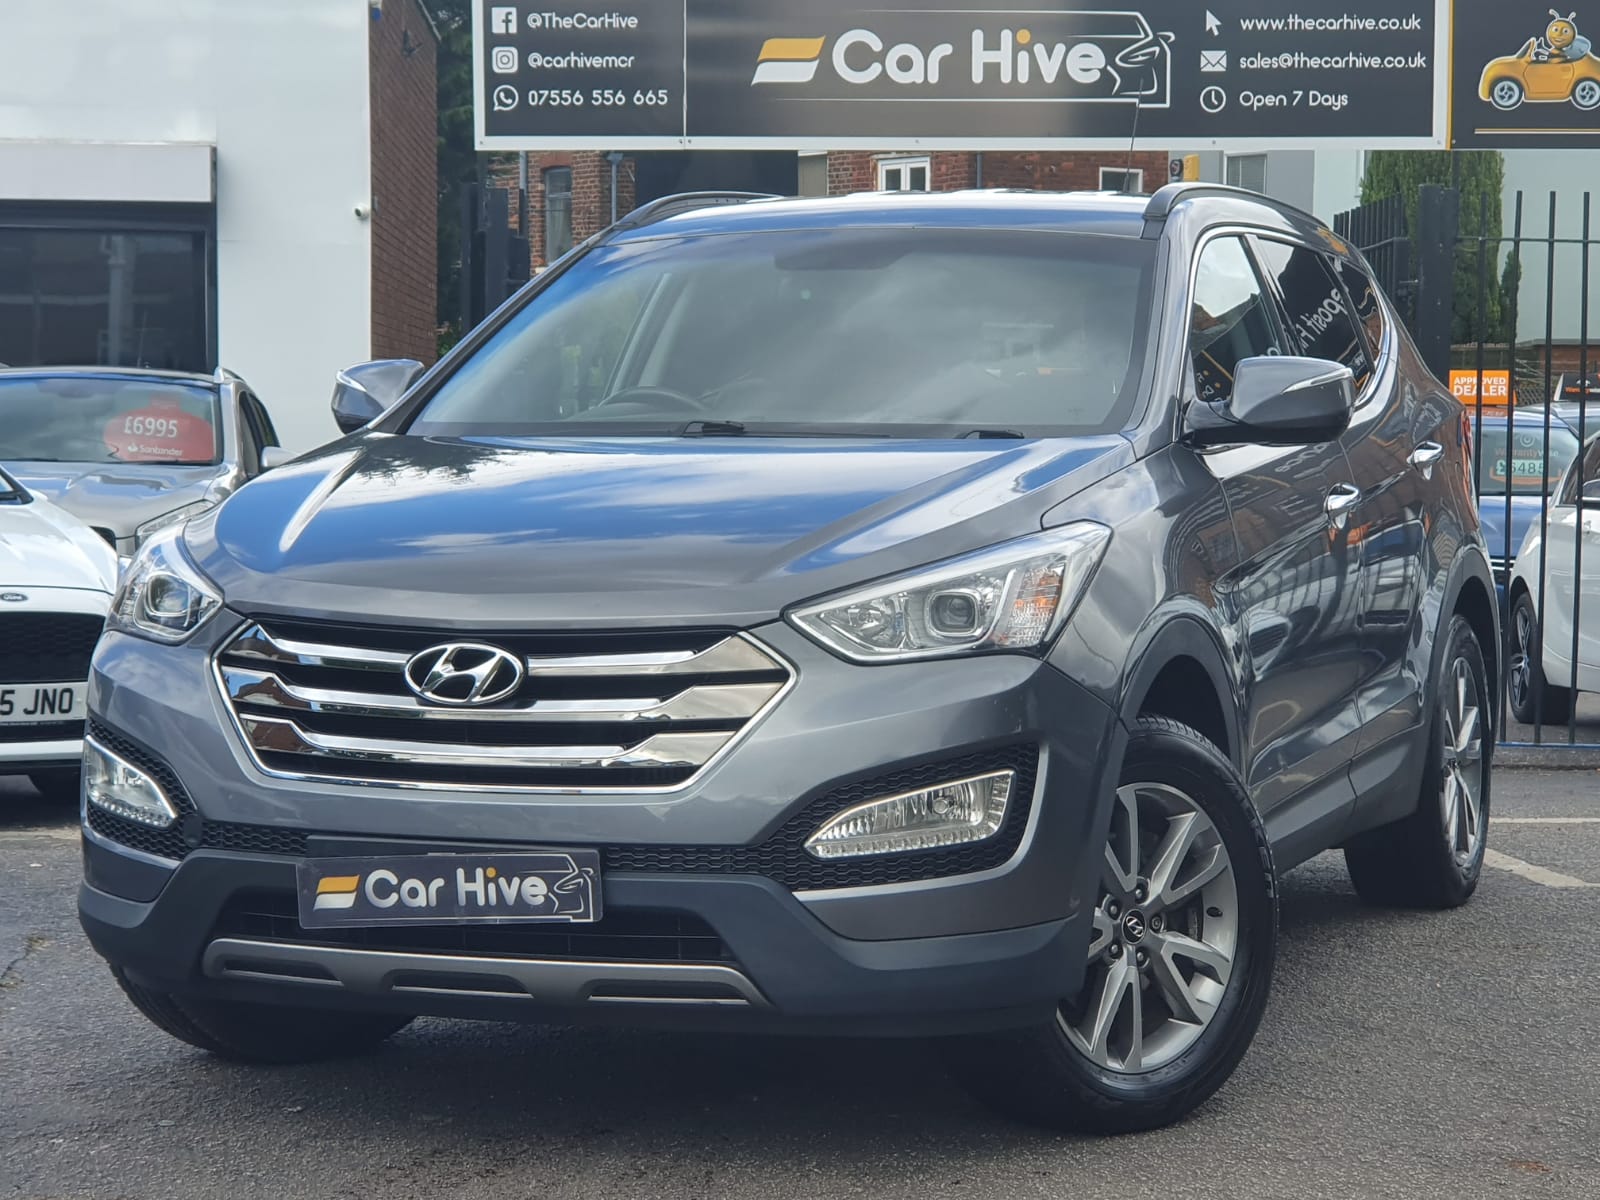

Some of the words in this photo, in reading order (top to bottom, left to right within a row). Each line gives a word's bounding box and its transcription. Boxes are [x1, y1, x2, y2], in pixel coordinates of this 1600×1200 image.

[527, 12, 638, 29] @TheCarHive
[1240, 14, 1421, 31] www.thecarhive.co.uk
[527, 52, 634, 69] @carhivemcr
[832, 29, 953, 84] Car
[971, 28, 1106, 84] Hive
[1239, 52, 1426, 70] sales@thecarhive.co.uk
[528, 90, 584, 106] 07556
[591, 90, 626, 106] 556
[633, 90, 668, 106] 665
[1239, 91, 1287, 110] Open
[1292, 92, 1303, 107] 7
[1308, 91, 1349, 110] Days
[124, 416, 178, 438] £6995
[139, 444, 183, 456] Santander
[23, 688, 74, 715] JNO
[365, 869, 444, 908] Car
[456, 867, 547, 906] Hive
